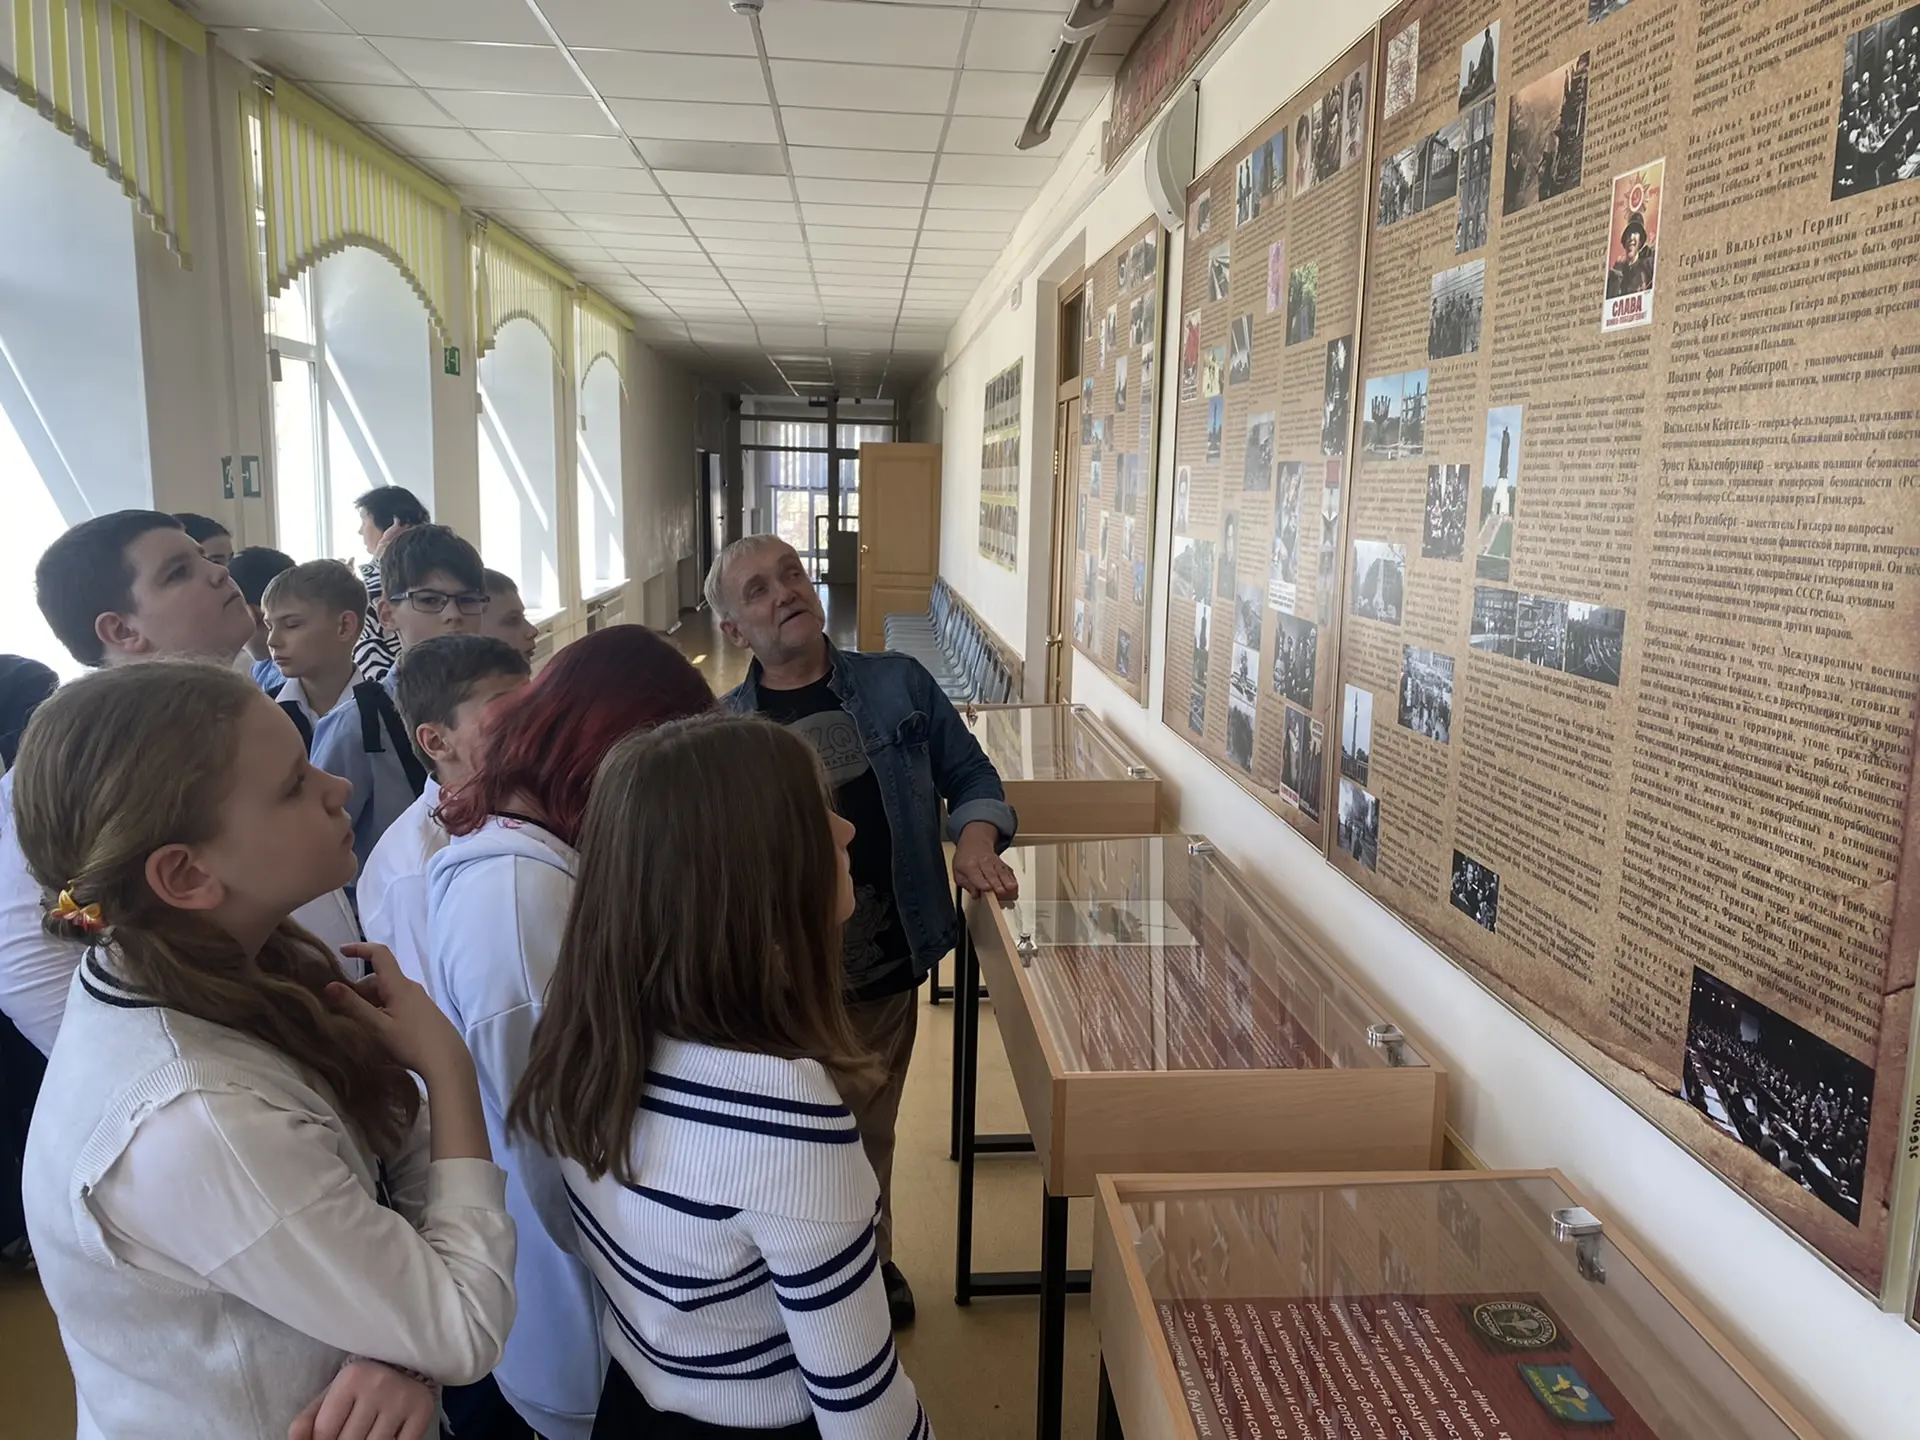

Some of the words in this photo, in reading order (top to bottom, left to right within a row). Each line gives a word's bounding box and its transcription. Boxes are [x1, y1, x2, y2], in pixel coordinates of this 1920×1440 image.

[1679, 249, 1717, 267] Герман
[1725, 228, 1792, 255] Вильгельм
[1802, 212, 1850, 234] Геринг
[1864, 221, 1903, 237] силами
[1612, 295, 1643, 317] СЛАВА
[1672, 316, 1708, 335] Рудольф
[1711, 314, 1730, 326] Гесс
[1839, 284, 1897, 306] руководству
[1667, 371, 1700, 383] Иоахим
[1705, 366, 1723, 381] фон
[1729, 360, 1787, 375] Риббентроп
[1804, 344, 1884, 370] уполномоченный
[1821, 371, 1861, 382] министр
[1663, 422, 1709, 433] Вильгельм
[1712, 419, 1750, 430] Кейтель
[1859, 410, 1913, 421] начальник
[1660, 459, 1684, 473] Эрнст
[1687, 457, 1763, 472] Кальтенбруннер
[1829, 476, 1892, 487] безопасности
[1693, 513, 1737, 529] Розенберг
[1847, 525, 1893, 537] вопросам
[1834, 543, 1869, 555] партии,
[1813, 575, 1879, 589] гитлеровцами
[1826, 559, 1884, 574] территорий.
[1795, 587, 1822, 602] СССР,
[1825, 590, 1844, 603] был
[1846, 596, 1894, 609] духовным
[1784, 621, 1812, 633] других
[1814, 626, 1853, 639] народов.
[1782, 646, 1862, 672] Международным
[1871, 666, 1919, 683] военным
[1777, 664, 1819, 682] преследуя
[1824, 674, 1845, 685] цель
[1849, 679, 1918, 700] установления
[1777, 681, 1842, 705] планировали,
[1851, 697, 1900, 715] готовили
[1742, 720, 1795, 743] территорий,
[1802, 736, 1829, 751] угоне
[1847, 714, 1881, 730] против
[1813, 757, 1849, 777] работы,
[1856, 768, 1907, 792] убийствах
[1786, 782, 1821, 800] военной
[1822, 794, 1903, 829] необходимостью,
[1746, 816, 1815, 852] политическим,
[1823, 846, 1868, 870] расовым
[1760, 806, 1820, 834] совершённых
[1841, 835, 1899, 863] отношении
[1806, 857, 1870, 889] человечности.
[1741, 869, 1795, 903] обвиняемому
[1808, 899, 1868, 933] отдельности.
[1767, 898, 1789, 915] через
[1840, 894, 1892, 927] Трибунала
[1719, 888, 1758, 918] Геринга,
[1764, 909, 1830, 953] Риббентропа,
[1741, 930, 1777, 960] Бормана,
[1755, 921, 1786, 948] Фрика,
[1788, 937, 1841, 975] Штрейхера,
[1183, 1311, 1197, 1333] Этот
[1349, 1303, 1374, 1333] группы
[1189, 1336, 1207, 1359] флаг
[1244, 1304, 1276, 1353] настоящий
[1267, 1356, 1291, 1394] героизм
[1286, 1304, 1325, 1361] специальной
[1315, 1363, 1345, 1401] военной
[1305, 1303, 1331, 1336] района
[1326, 1340, 1363, 1390] Луганской
[1328, 1303, 1372, 1364] принимавшей
[1360, 1366, 1392, 1405] участие
[1367, 1334, 1388, 1352] 76-й
[1391, 1301, 1416, 1329] отвагу
[1414, 1338, 1460, 1398] преданность
[1415, 1307, 1439, 1333] Девиз
[1433, 1336, 1465, 1372] дивизии
[1160, 1304, 1187, 1366] напоминание
[1180, 1369, 1194, 1385] для
[1187, 1389, 1210, 1435] будущих
[1203, 1311, 1229, 1358] мужестве,
[1223, 1360, 1251, 1411] стойкости
[1223, 1304, 1242, 1336] героев,
[1235, 1339, 1275, 1412] участвовавших
[1267, 1311, 1282, 1327] Под
[1277, 1331, 1320, 1406] командованием
[1377, 1354, 1408, 1391] дивизии
[1379, 1319, 1406, 1350] нашем
[1401, 1355, 1438, 1404] музейном
[1208, 1381, 1228, 1414] только
